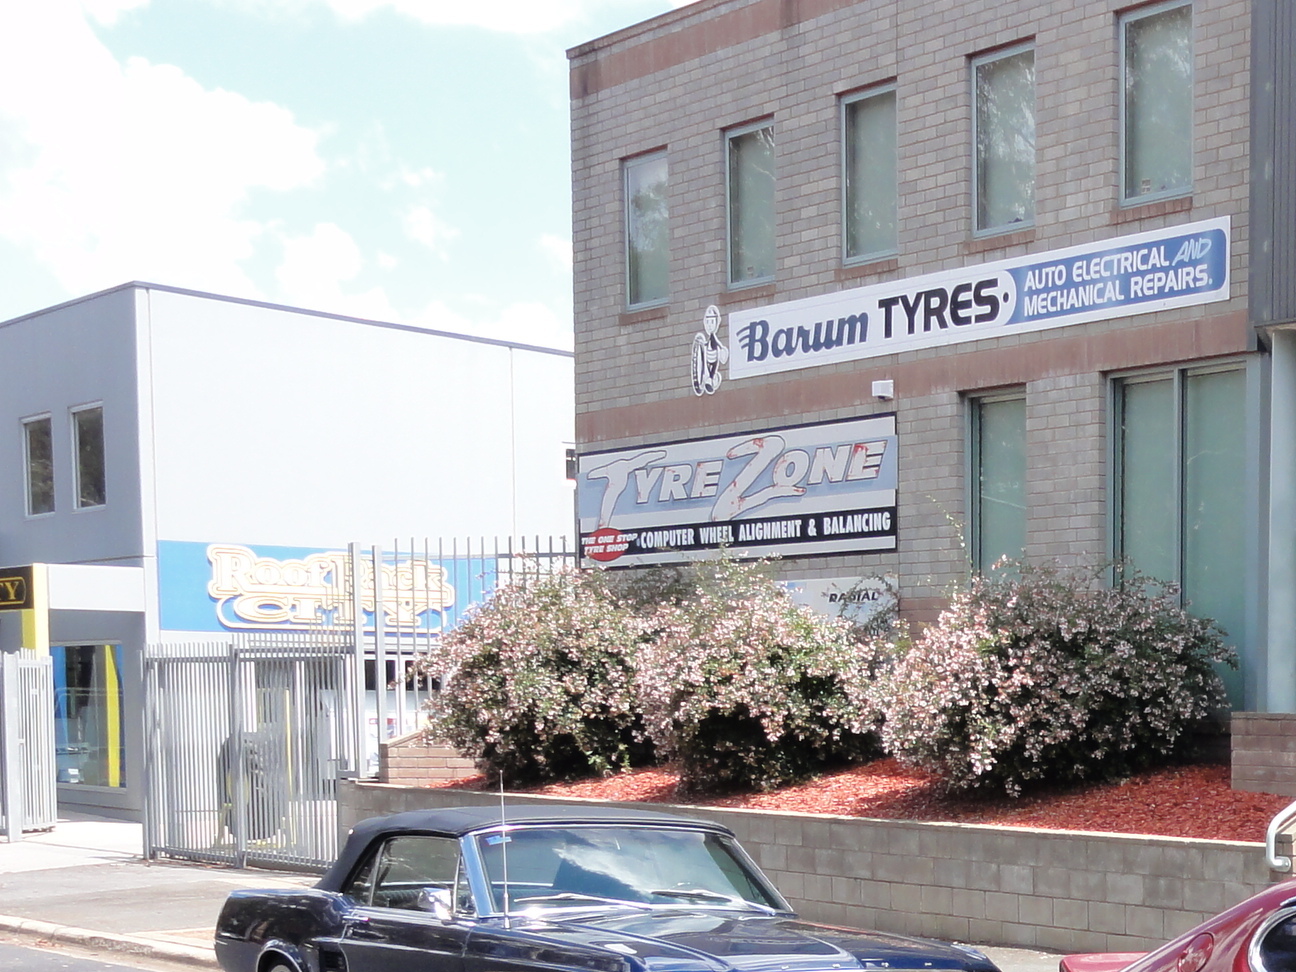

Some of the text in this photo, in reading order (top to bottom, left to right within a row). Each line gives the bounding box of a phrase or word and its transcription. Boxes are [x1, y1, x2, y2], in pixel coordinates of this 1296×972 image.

[1024, 237, 1212, 291] AUTO ELECTRICAL AND
[1024, 264, 1213, 316] MECHANICAL REPAIRS.
[736, 311, 869, 363] Barum
[581, 533, 638, 545] THE ONE STOP
[584, 543, 629, 554] TYRE SHOP
[640, 511, 891, 549] COMPUTER WHEEL ALIGNMENT & BALANCING
